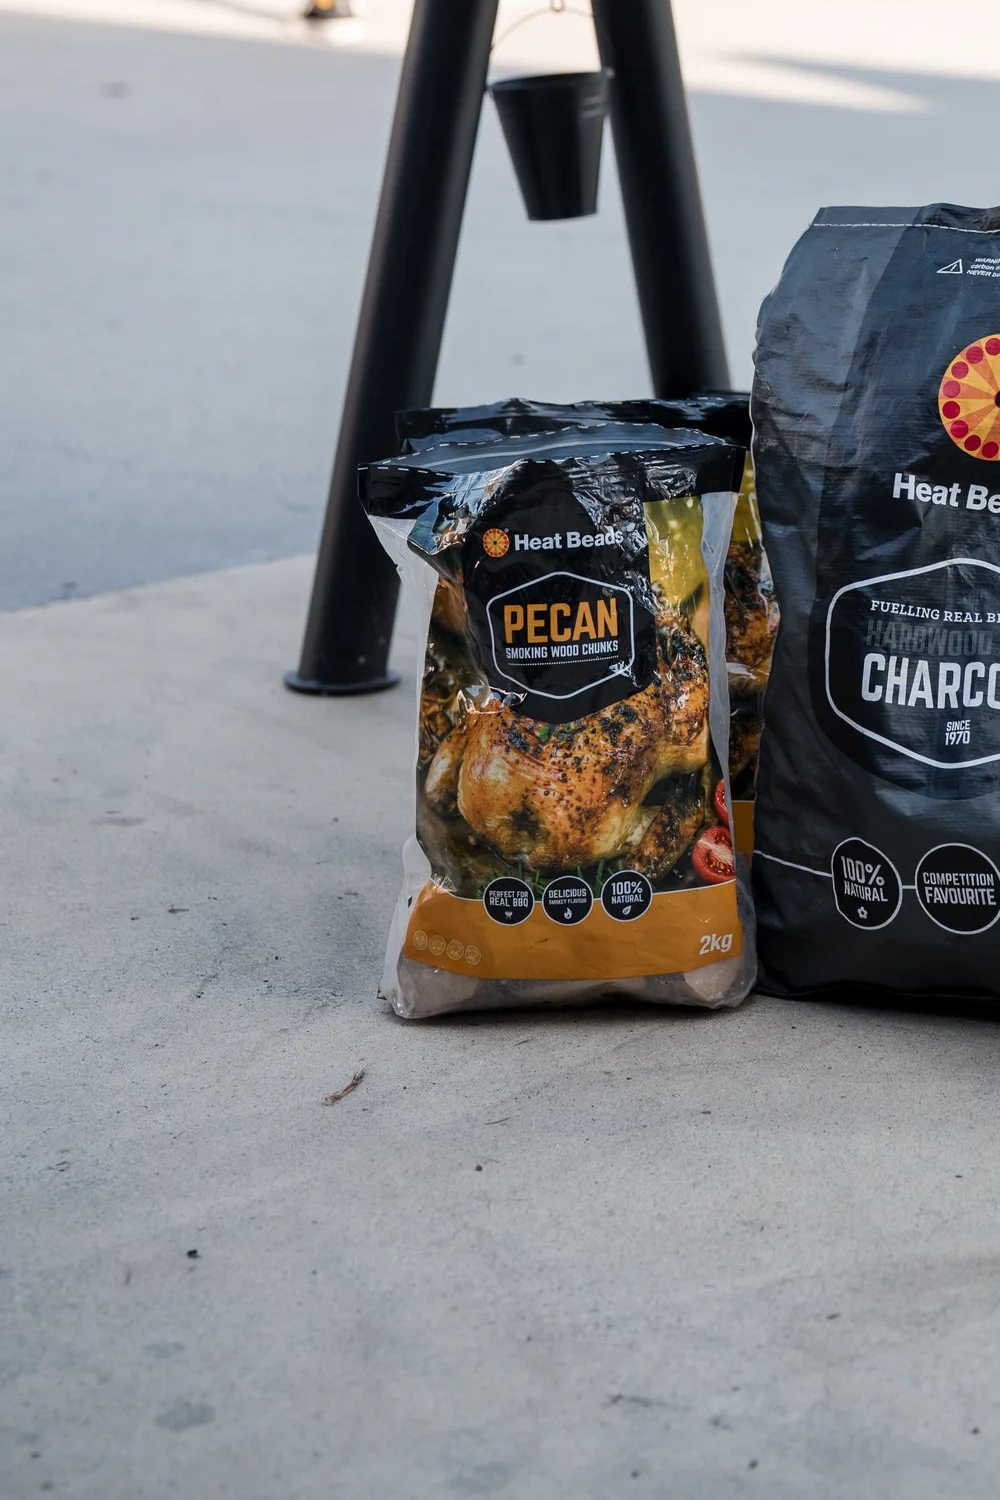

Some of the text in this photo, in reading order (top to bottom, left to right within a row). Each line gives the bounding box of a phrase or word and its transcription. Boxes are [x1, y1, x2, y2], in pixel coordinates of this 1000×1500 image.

[966, 269, 992, 277] NEVER
[970, 263, 995, 271] carbon
[892, 472, 962, 508] Heat
[514, 533, 563, 551] Heat
[870, 600, 940, 621] FUELLING
[943, 610, 983, 623] REAL
[504, 597, 619, 644] PECAN
[506, 640, 619, 659] SMOKING WOOD CHUNKS
[946, 720, 971, 732] SINCE
[945, 730, 970, 746] 1970
[840, 855, 885, 887] 100%
[923, 871, 995, 886] COMPETITION
[489, 890, 529, 899] PERFECT FOR
[548, 888, 587, 899] DELICIOUS
[611, 881, 643, 896] 100%
[844, 882, 888, 903] NATURAL
[925, 887, 997, 906] FAVOURITE
[489, 897, 529, 908] REAL BBQ
[611, 894, 643, 904] NATURAL
[699, 931, 733, 956] 2kg
